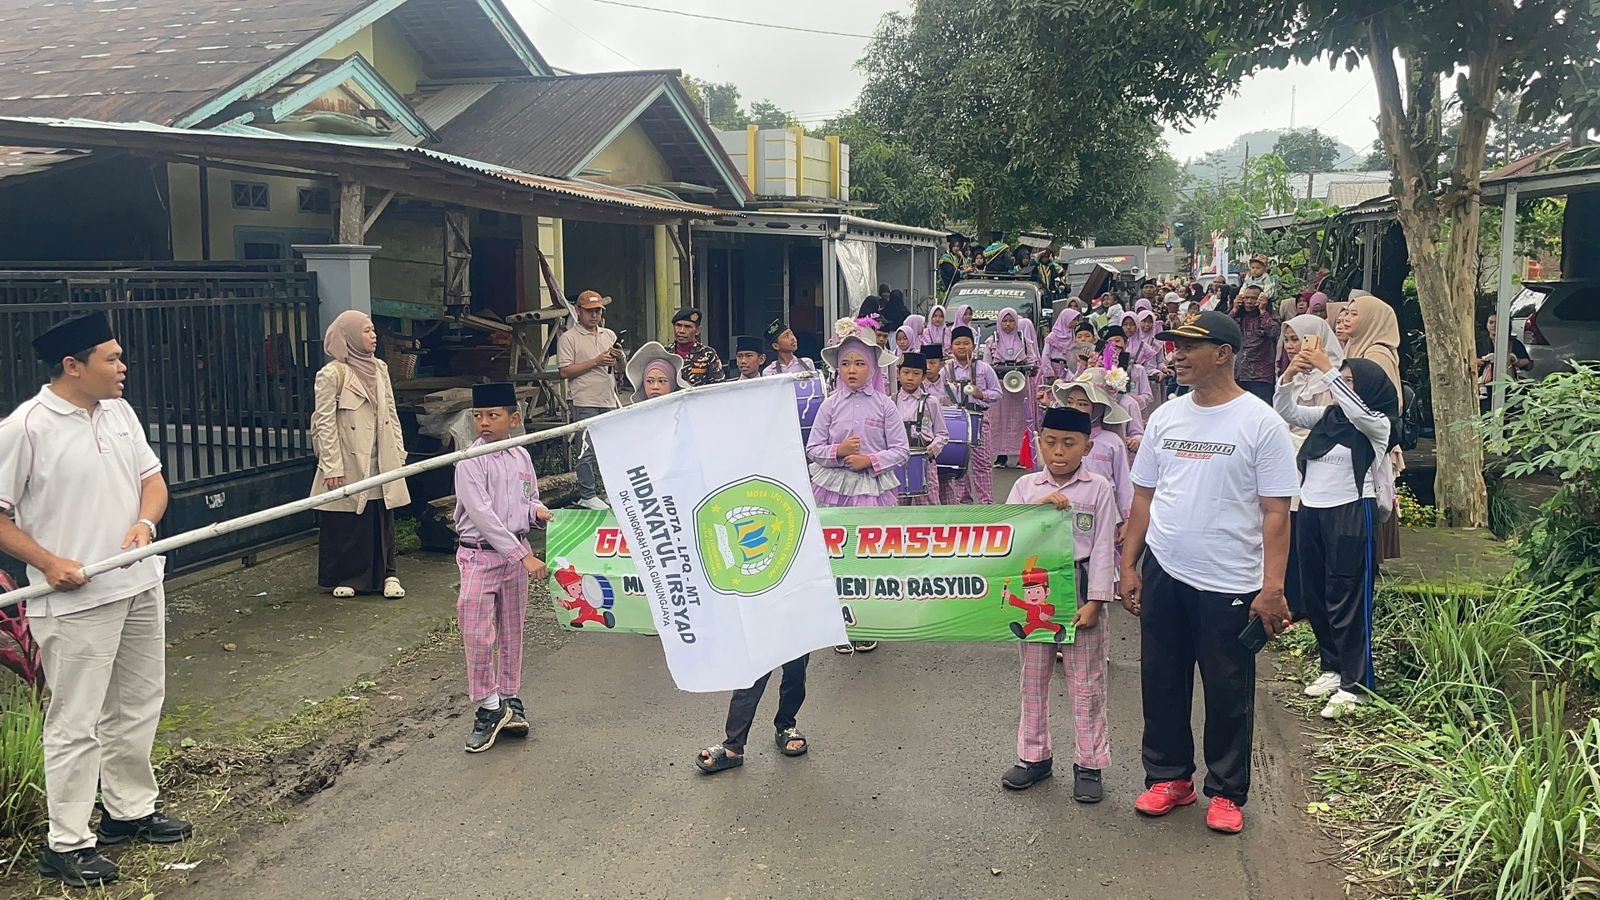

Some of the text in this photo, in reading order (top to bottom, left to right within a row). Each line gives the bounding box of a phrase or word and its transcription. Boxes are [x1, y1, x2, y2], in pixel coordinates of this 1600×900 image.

[958, 288, 992, 296] BLACK
[993, 288, 1026, 297] SWEET
[1162, 439, 1235, 455] PEMALANG
[626, 465, 697, 645] HIDAYATUL IRSYAD
[662, 495, 682, 533] MDTA
[677, 546, 692, 573] LPQ
[686, 586, 701, 606] MT
[823, 526, 846, 557] R
[856, 524, 1013, 557] RASYIID
[625, 506, 648, 552] LUNGKRAH
[642, 549, 656, 572] DESA
[650, 571, 671, 627] GUNUNGJAYA
[835, 577, 867, 596] IEN
[875, 577, 901, 596] AR
[908, 576, 985, 596] RASYIID
